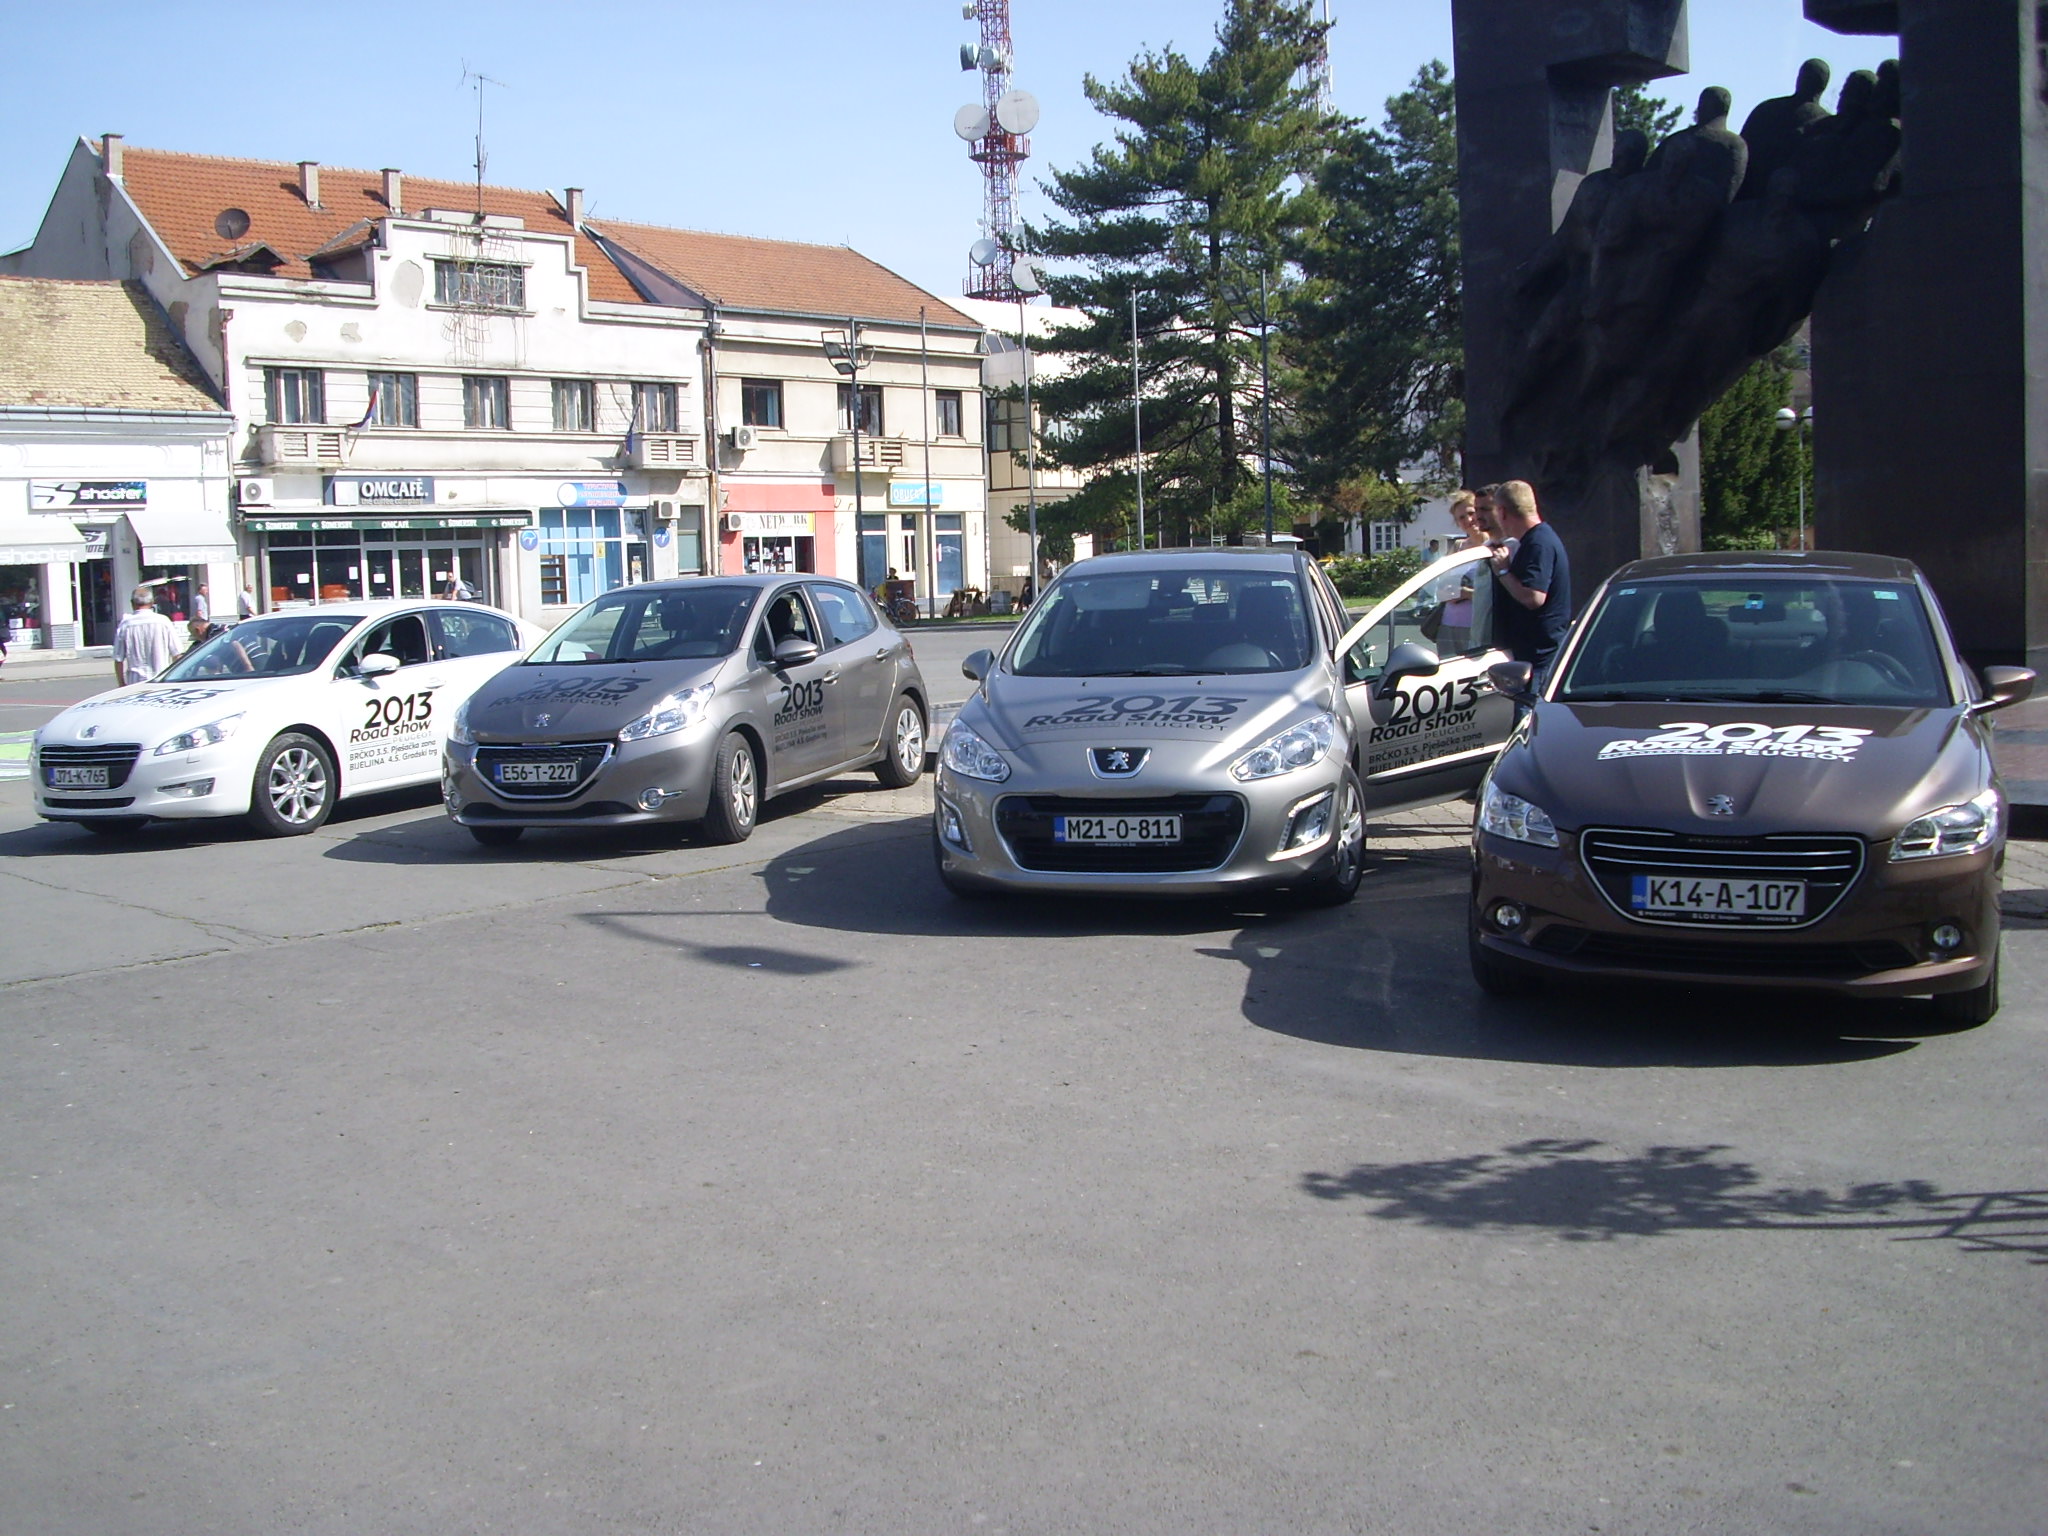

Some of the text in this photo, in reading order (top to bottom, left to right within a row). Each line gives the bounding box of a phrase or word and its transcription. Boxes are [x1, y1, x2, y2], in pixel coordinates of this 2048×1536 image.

[80, 487, 144, 500] shooter
[760, 514, 807, 529] NETWRK
[154, 548, 225, 562] shooter
[517, 676, 652, 696] 2013
[554, 688, 629, 701] show
[780, 679, 823, 713] 2013
[1388, 676, 1479, 726] 2013
[364, 691, 433, 730] 2013
[1062, 696, 1247, 717] 2013
[774, 709, 798, 727] Road
[800, 705, 823, 720] show
[1023, 710, 1230, 728] Road show
[350, 720, 432, 743] Road show
[1125, 722, 1228, 732] PEUGEOT
[1369, 709, 1477, 744] Road show
[1424, 722, 1477, 739] PEUGEOT
[1644, 722, 1874, 747] 2013
[393, 731, 432, 743] PEUGEOT
[1599, 739, 1858, 755] Road show
[1726, 749, 1855, 762] PEUGEOT
[502, 765, 574, 780] E56-T-227
[1650, 880, 1800, 911] K14-A-107
